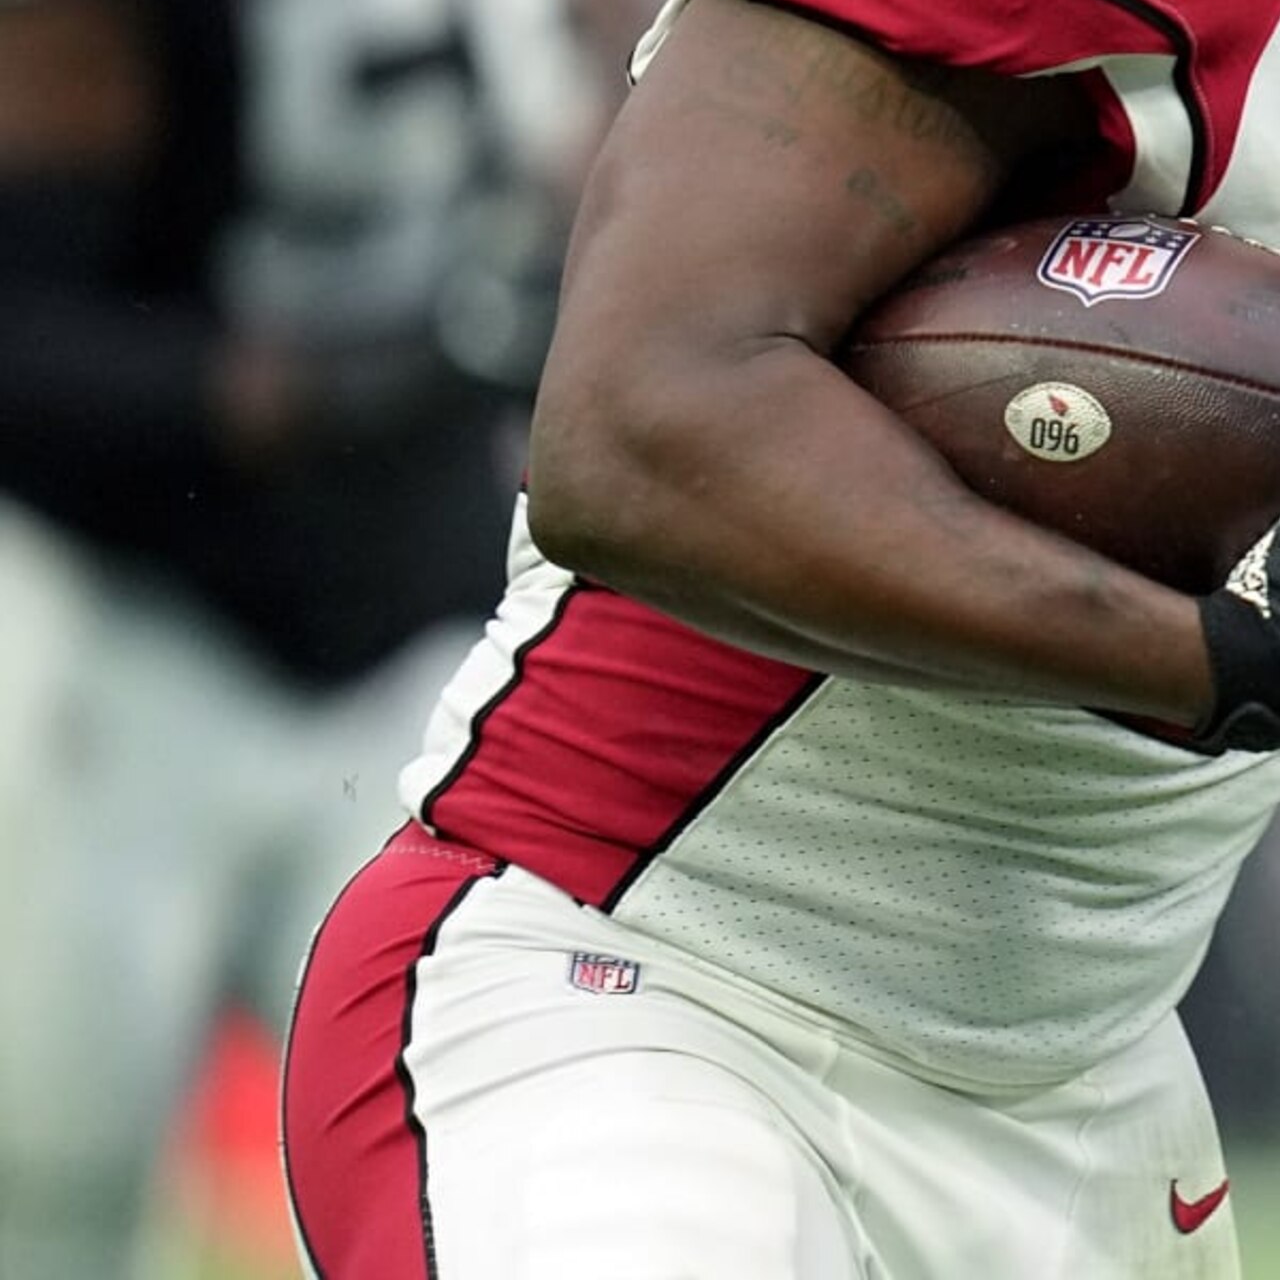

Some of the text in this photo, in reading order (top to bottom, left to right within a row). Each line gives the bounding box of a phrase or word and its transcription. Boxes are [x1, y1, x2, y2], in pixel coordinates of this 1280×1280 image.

[1053, 240, 1156, 287] NFL
[1030, 417, 1080, 455] 096
[579, 963, 632, 989] NFL
